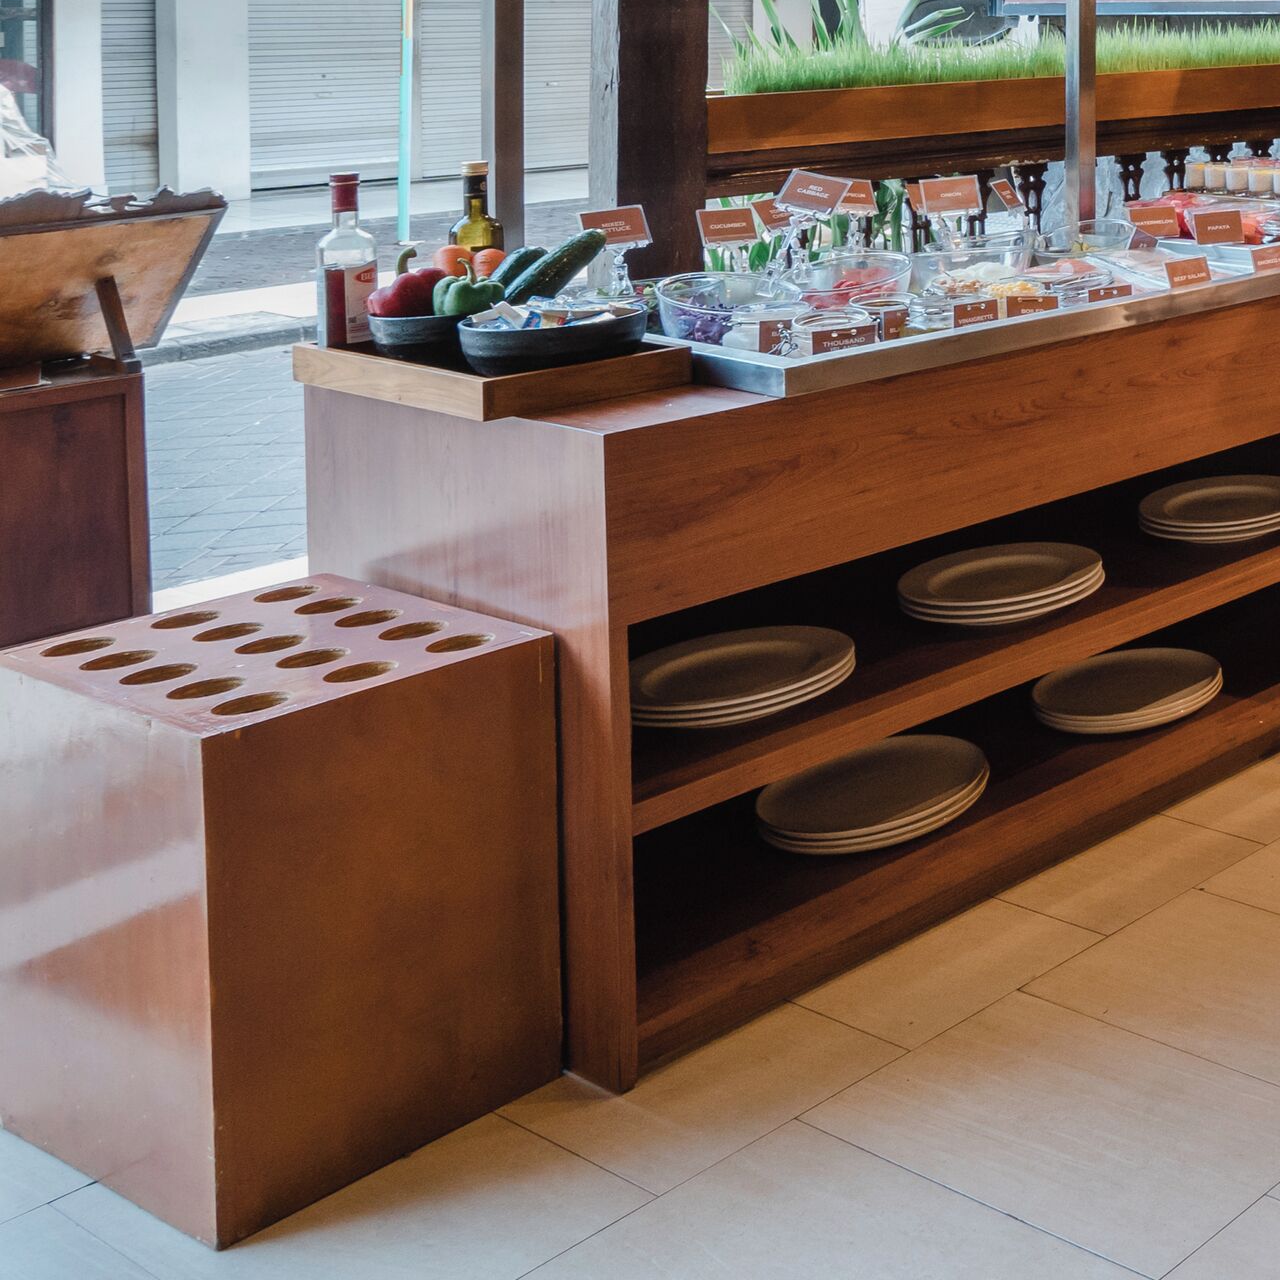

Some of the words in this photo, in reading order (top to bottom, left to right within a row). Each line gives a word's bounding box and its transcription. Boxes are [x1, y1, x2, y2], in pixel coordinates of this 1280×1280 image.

[808, 184, 823, 192] RED
[797, 187, 830, 199] CABBAGE
[605, 225, 632, 233] ETTUCE
[709, 222, 747, 230] CUCUMBER
[1207, 224, 1231, 232] PAPAYA
[958, 313, 994, 325] VINAIGRETTE
[822, 336, 866, 348] THOUSAND
